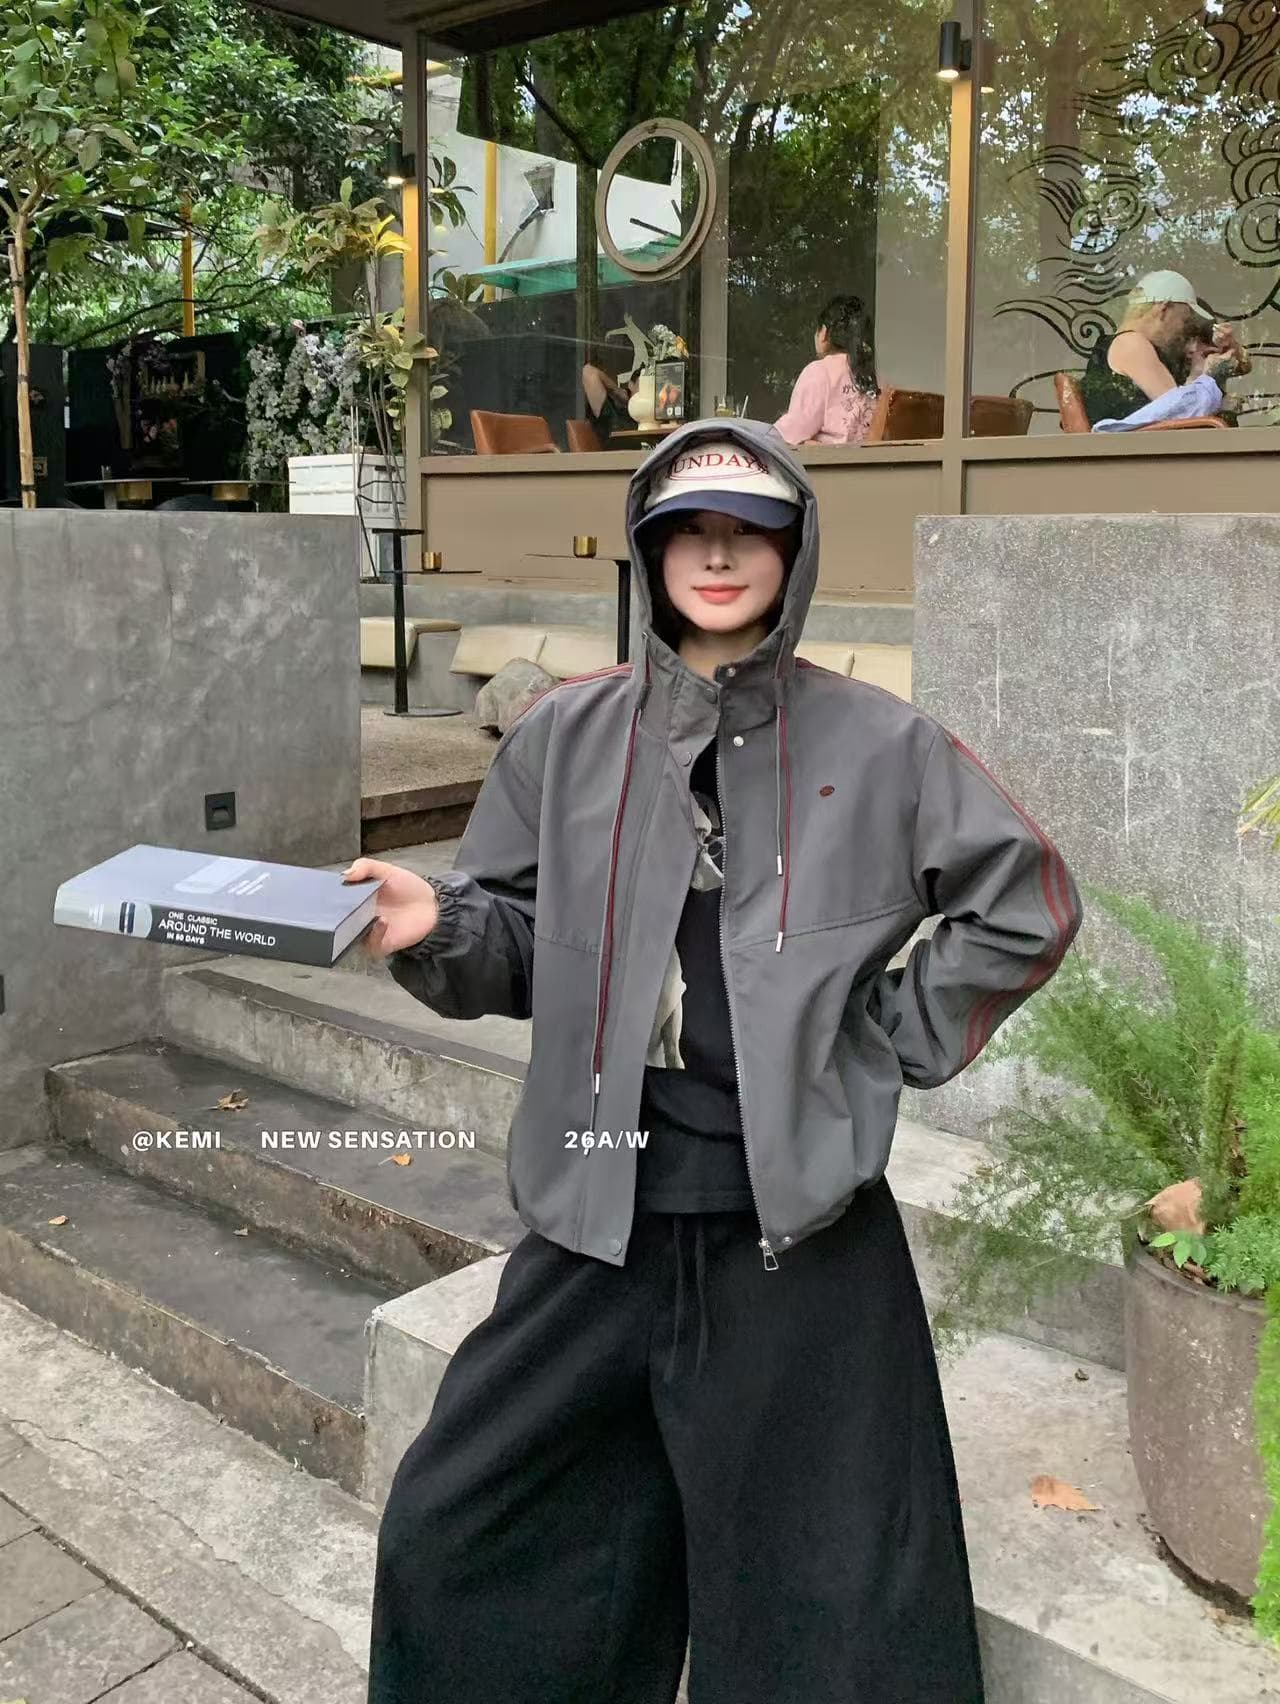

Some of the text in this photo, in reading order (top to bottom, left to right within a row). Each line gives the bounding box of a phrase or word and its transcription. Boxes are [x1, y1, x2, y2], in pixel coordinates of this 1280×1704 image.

[168, 911, 218, 925] ONE CLASSIC
[158, 919, 276, 946] AROUND THE WORLD
[166, 932, 174, 940] IN
[185, 935, 205, 945] DAYS
